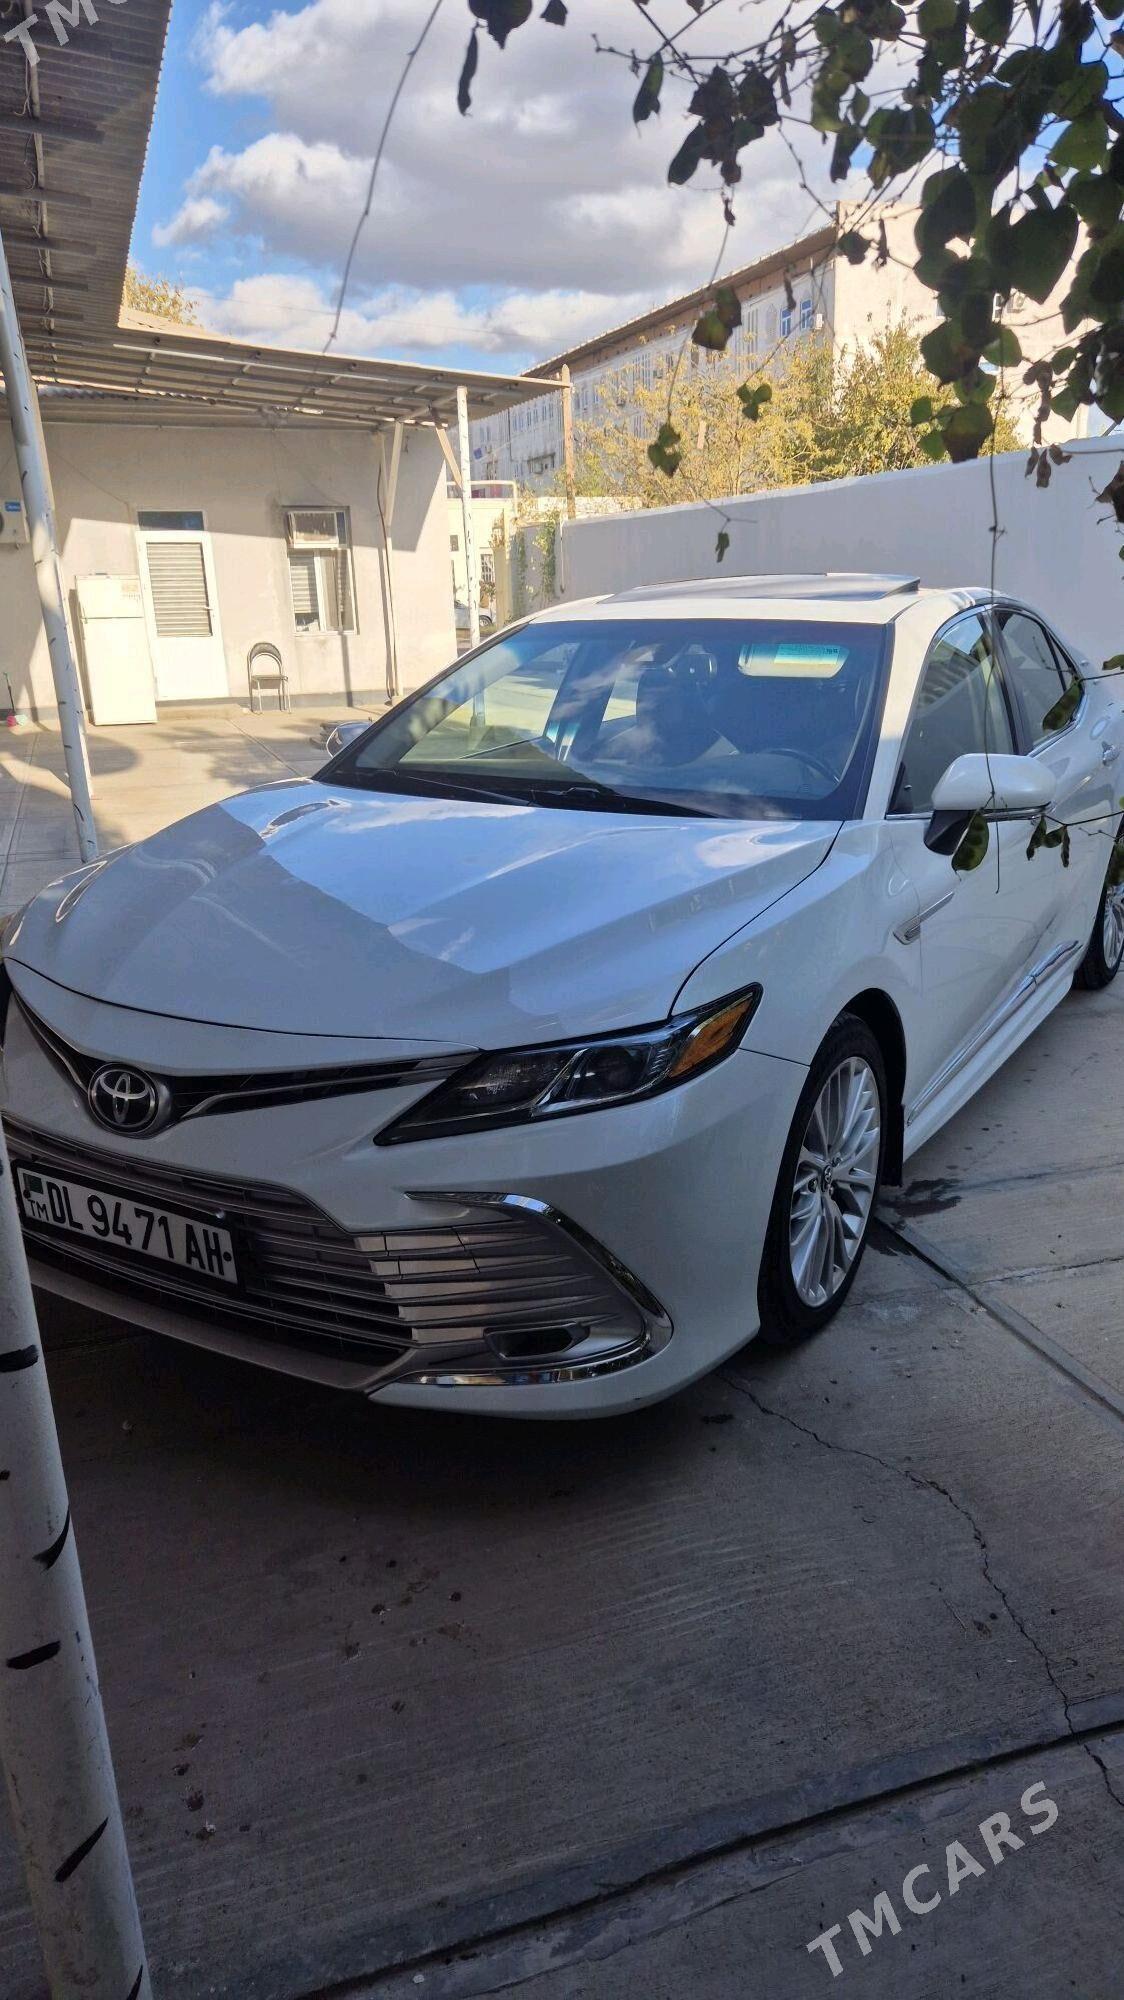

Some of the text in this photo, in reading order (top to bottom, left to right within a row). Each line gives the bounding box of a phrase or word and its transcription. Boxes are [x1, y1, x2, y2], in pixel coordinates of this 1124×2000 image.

[28, 1199, 50, 1222] TM
[46, 1181, 225, 1276] DL 9471 AH
